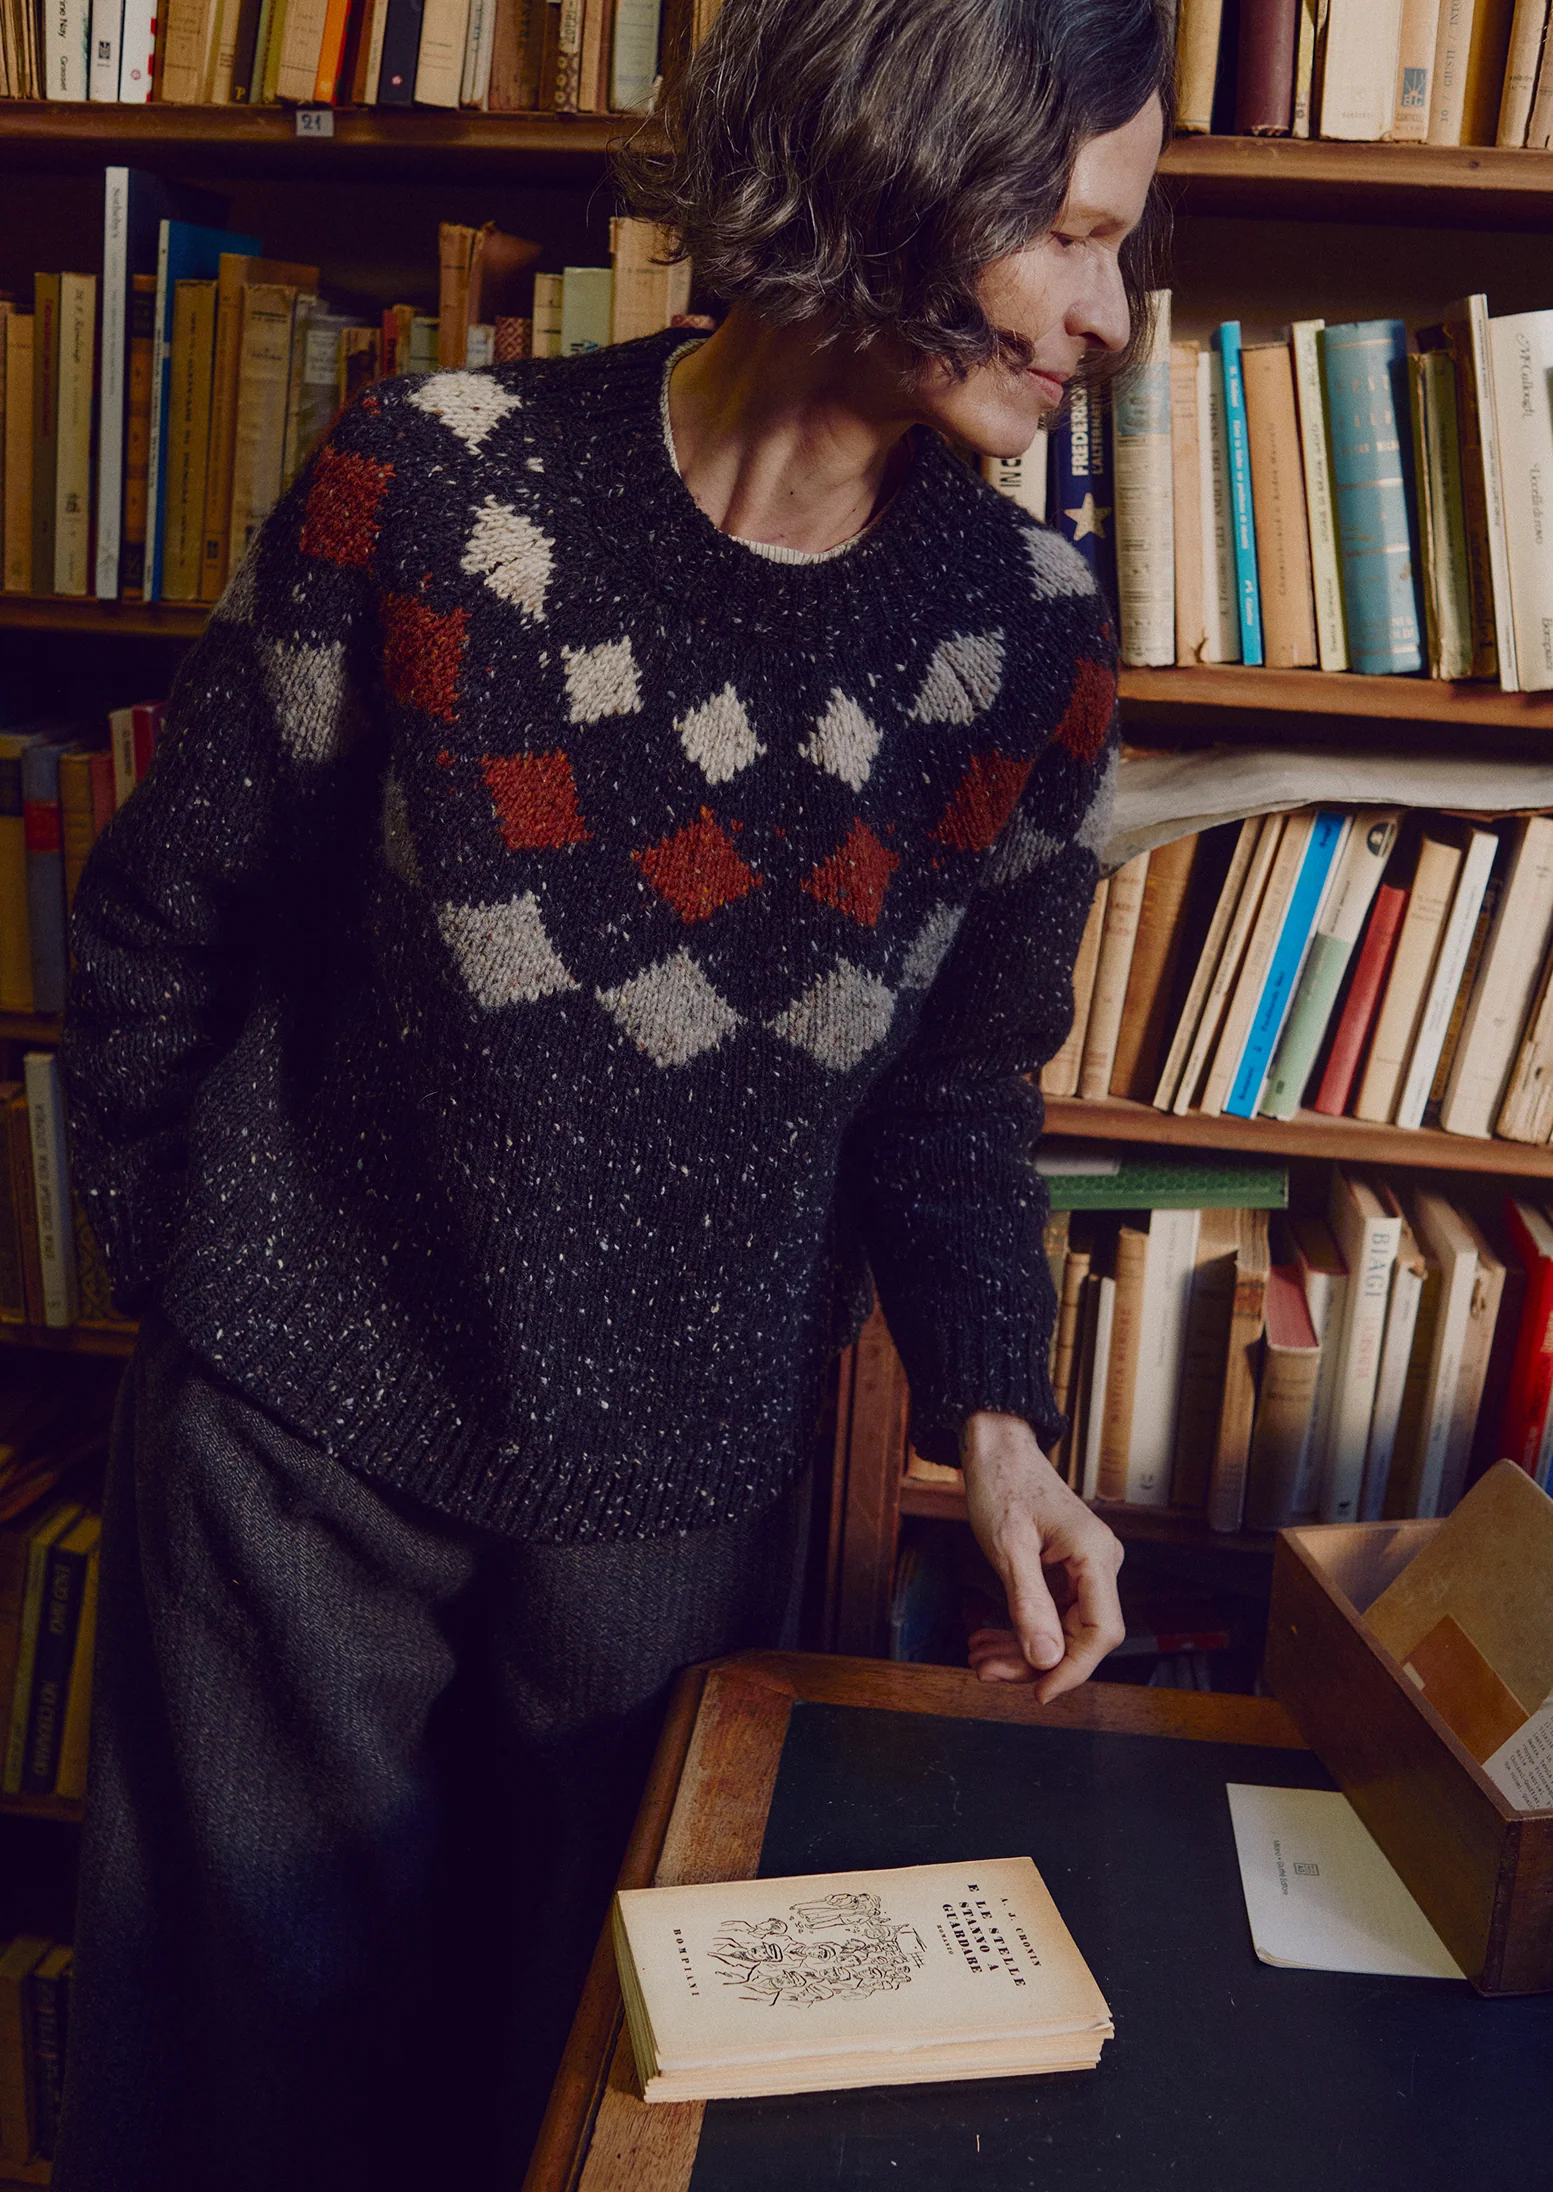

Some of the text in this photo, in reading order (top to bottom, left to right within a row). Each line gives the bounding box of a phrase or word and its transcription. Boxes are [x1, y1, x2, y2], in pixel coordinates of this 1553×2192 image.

[57, 18, 69, 39] Nay
[1444, 50, 1456, 87] GIUSTI
[301, 113, 322, 130] 21
[1440, 110, 1449, 122] 10
[1364, 1232, 1390, 1297] BIAGI
[673, 1928, 700, 1997] BOMPIANI
[937, 1924, 954, 1955] ROMANZO
[942, 1904, 983, 1974] GUARDARE
[959, 1902, 999, 1972] STANNO A
[967, 1884, 1026, 1987] E LE STELLE
[1000, 1897, 1041, 1967] A. J. CRONIN
